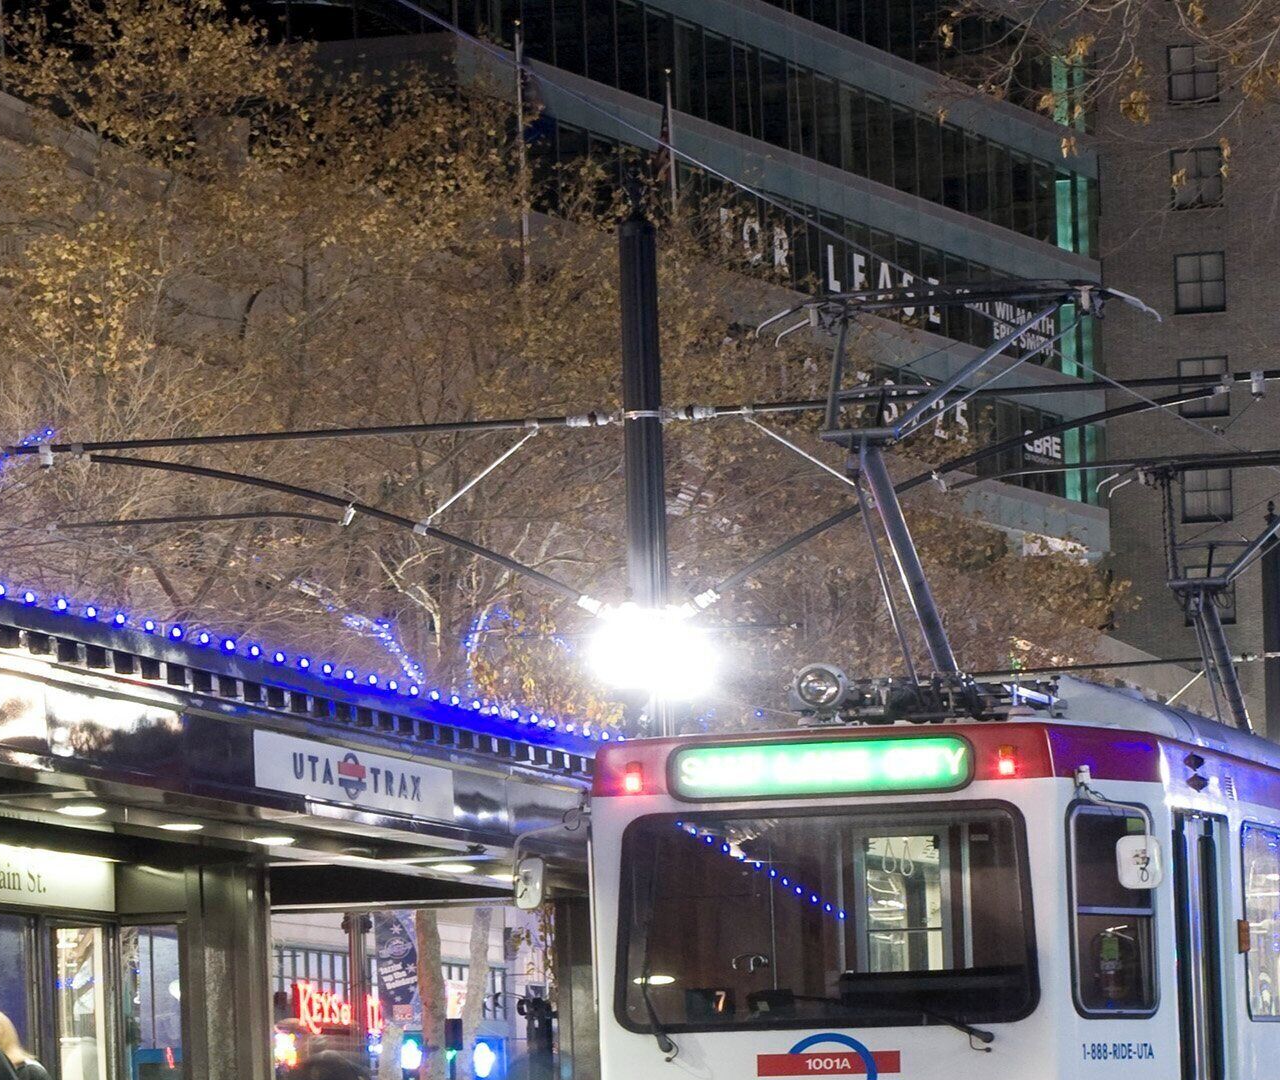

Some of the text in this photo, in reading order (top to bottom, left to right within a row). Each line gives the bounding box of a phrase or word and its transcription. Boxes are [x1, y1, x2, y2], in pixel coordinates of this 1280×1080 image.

[293, 752, 421, 801] UTA TRAX
[297, 980, 340, 1034] KEYS
[715, 990, 726, 1012] 7
[1082, 1043, 1155, 1060] 1-888-RIDE-UTA
[806, 1057, 851, 1070] 1001A
